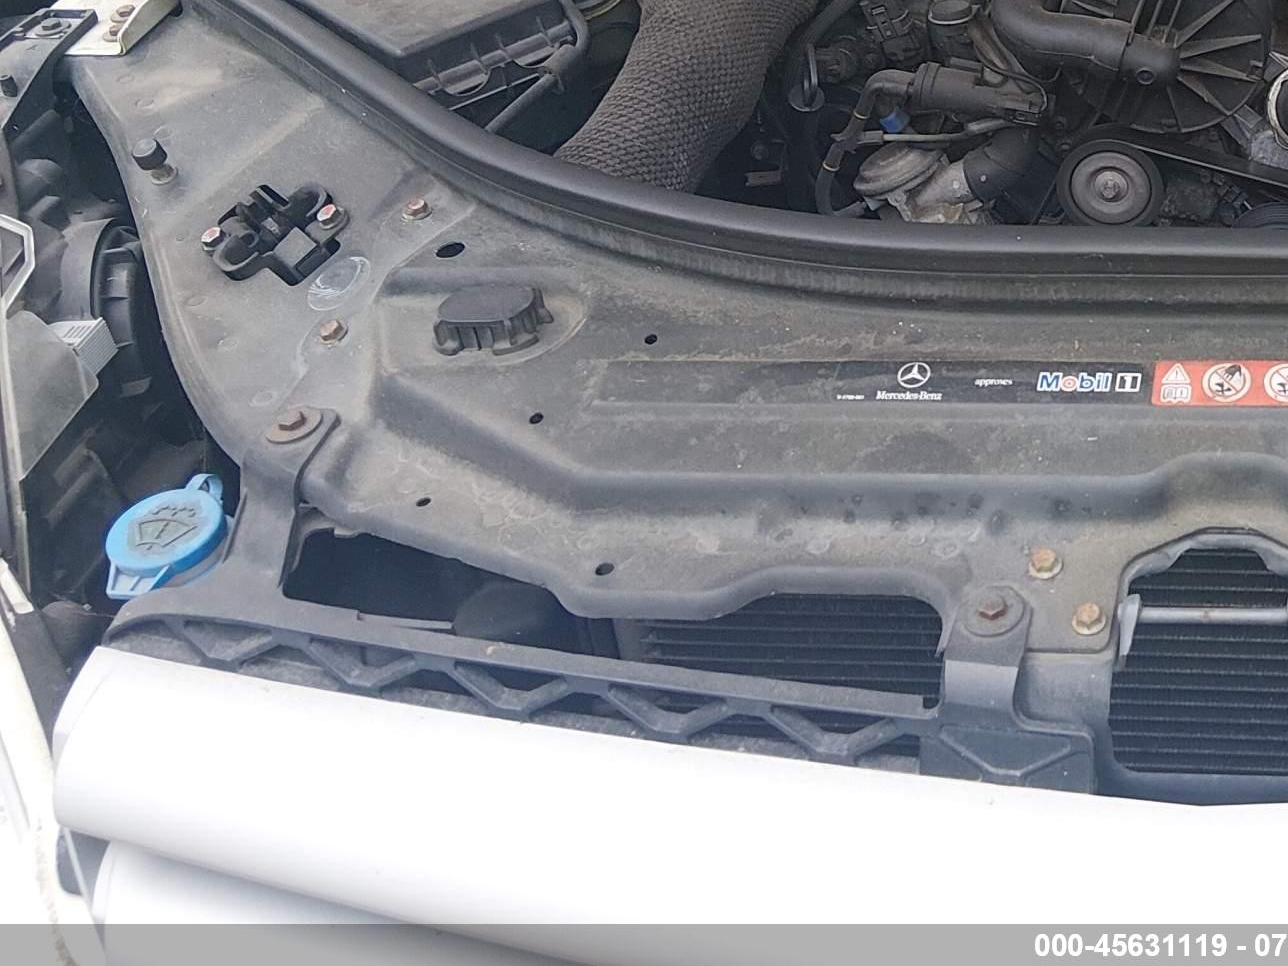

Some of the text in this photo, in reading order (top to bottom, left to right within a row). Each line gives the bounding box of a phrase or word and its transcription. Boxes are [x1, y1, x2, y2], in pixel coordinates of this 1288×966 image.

[975, 378, 1013, 387] approves
[1036, 371, 1112, 392] Mobil
[875, 390, 943, 401] Mercedes-Benz
